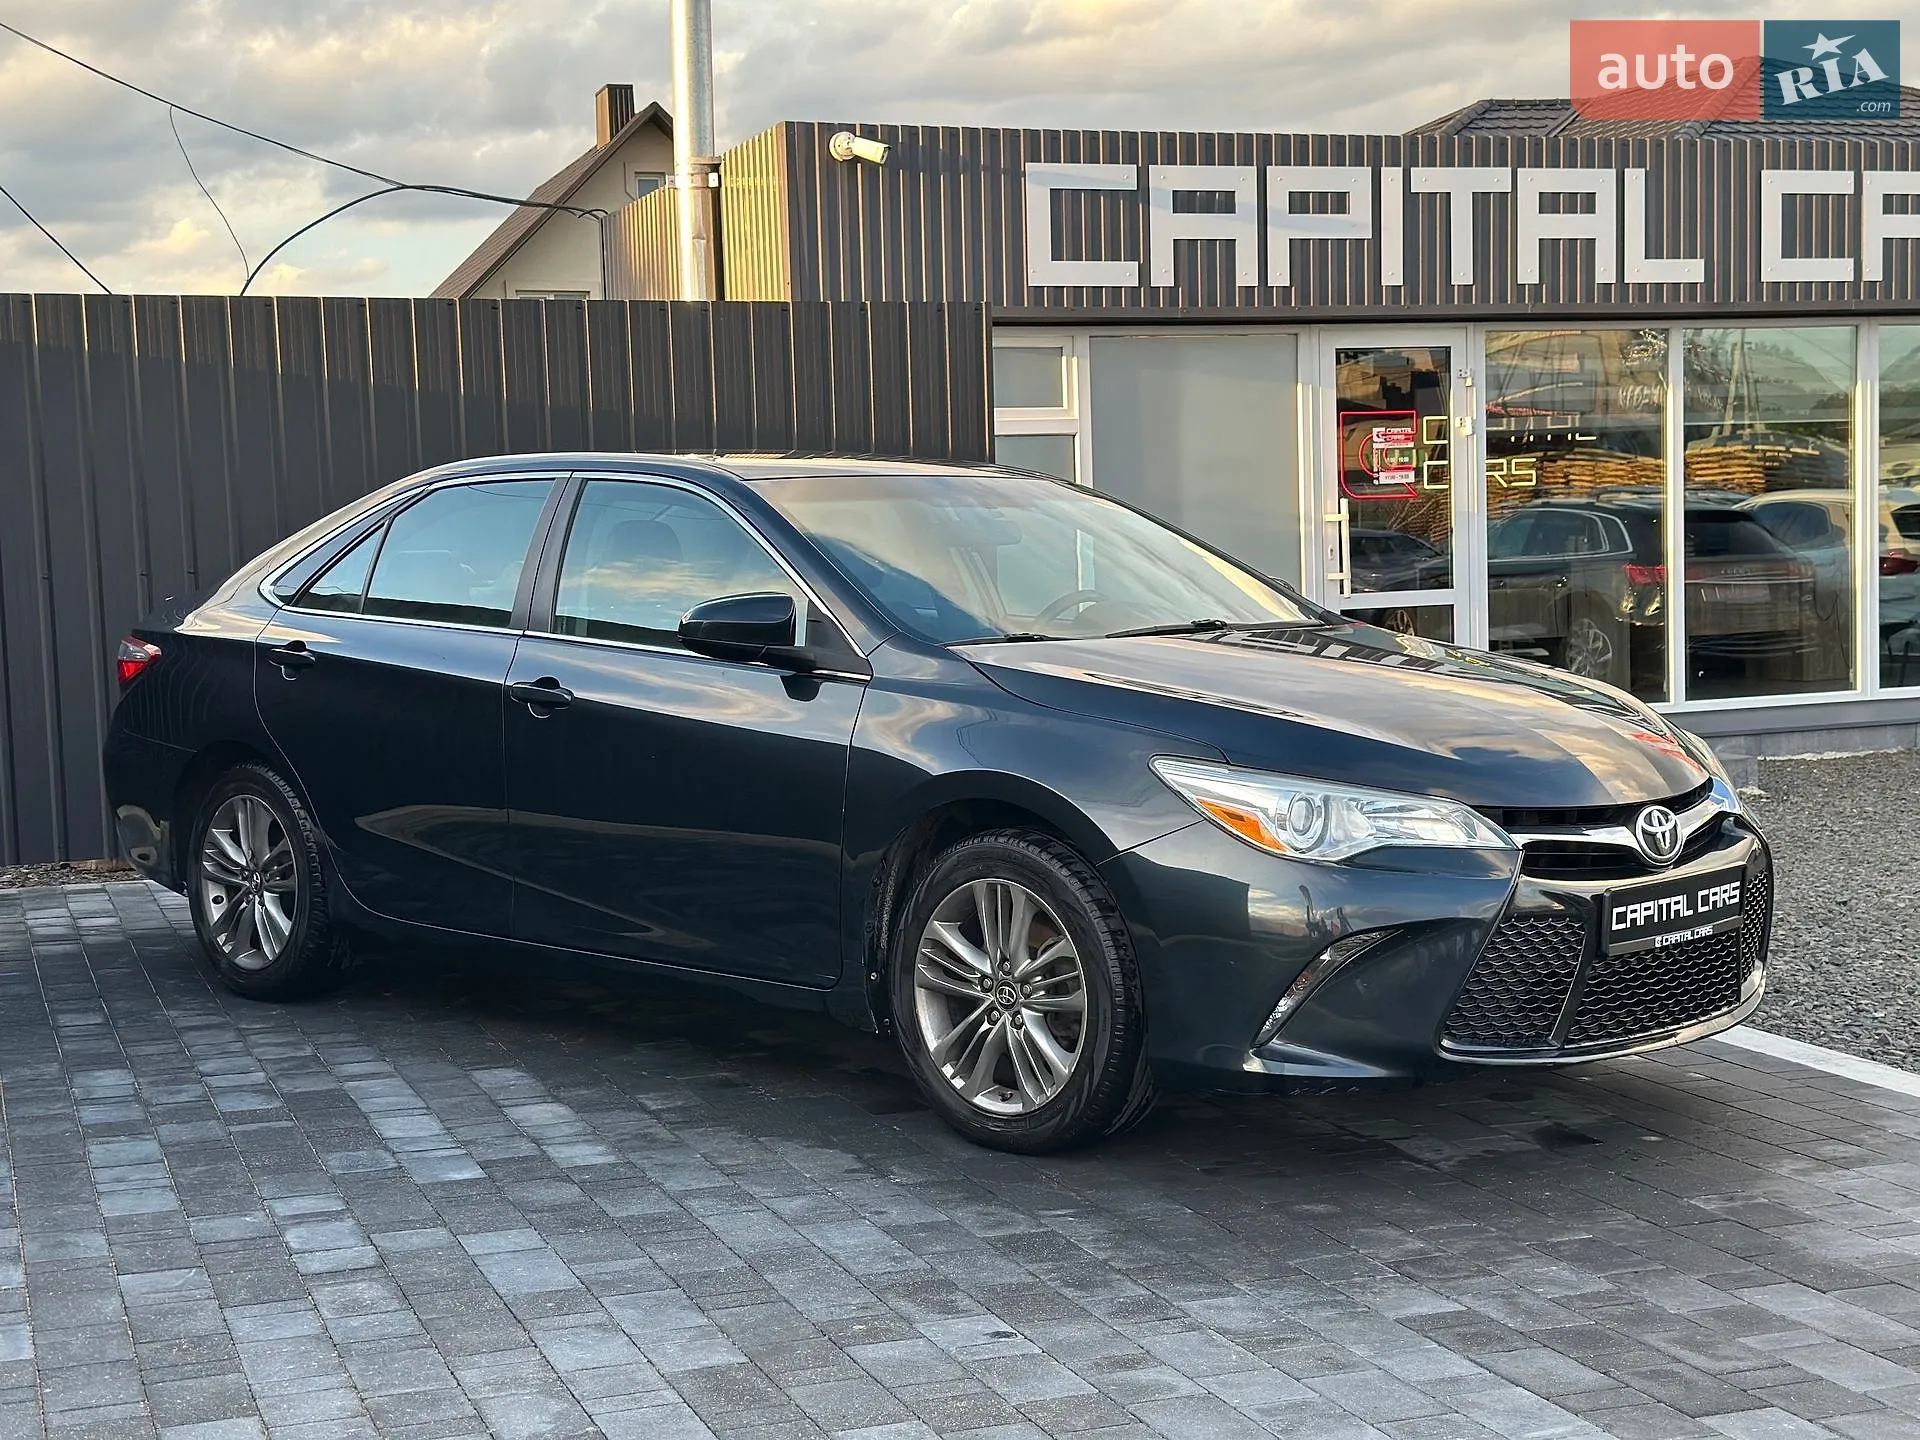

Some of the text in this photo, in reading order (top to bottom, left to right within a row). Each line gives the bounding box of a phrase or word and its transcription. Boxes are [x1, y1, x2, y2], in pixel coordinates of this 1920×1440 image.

[1025, 163, 1704, 287] CAPITAL
[1423, 458, 1537, 489] CRS
[1611, 881, 1741, 931] CAPITAL CARS
[1663, 925, 1714, 946] CAPITAL CARS
